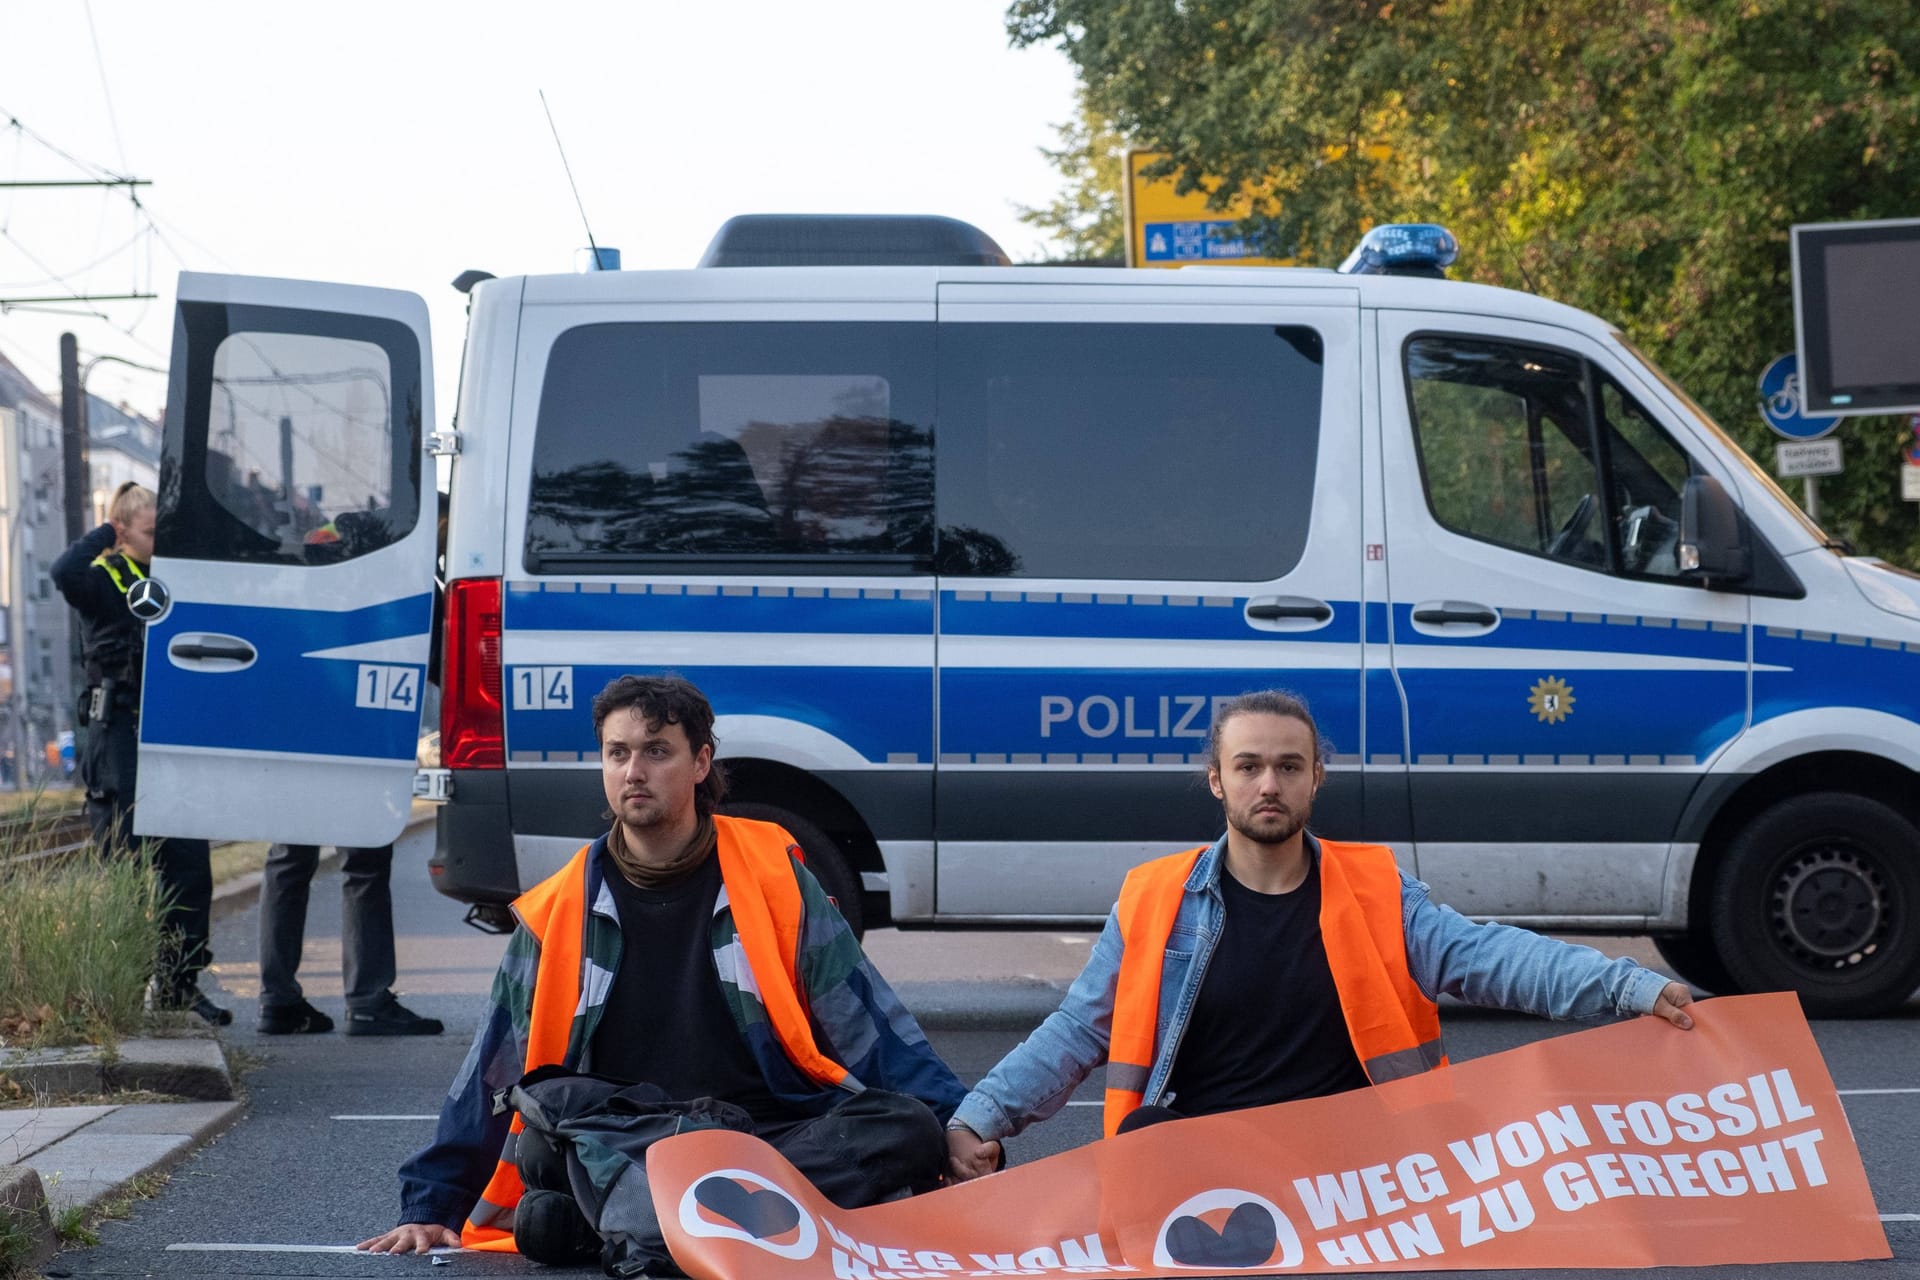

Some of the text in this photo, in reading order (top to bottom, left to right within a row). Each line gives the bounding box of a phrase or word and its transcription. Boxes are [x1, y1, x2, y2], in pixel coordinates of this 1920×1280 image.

[366, 669, 412, 706] 14
[521, 670, 569, 706] 14
[1293, 1068, 1815, 1231] WEG VON FOSSIL
[1316, 1129, 1828, 1266] HIN ZU GERECHT
[820, 1215, 1109, 1271] WEG VON
